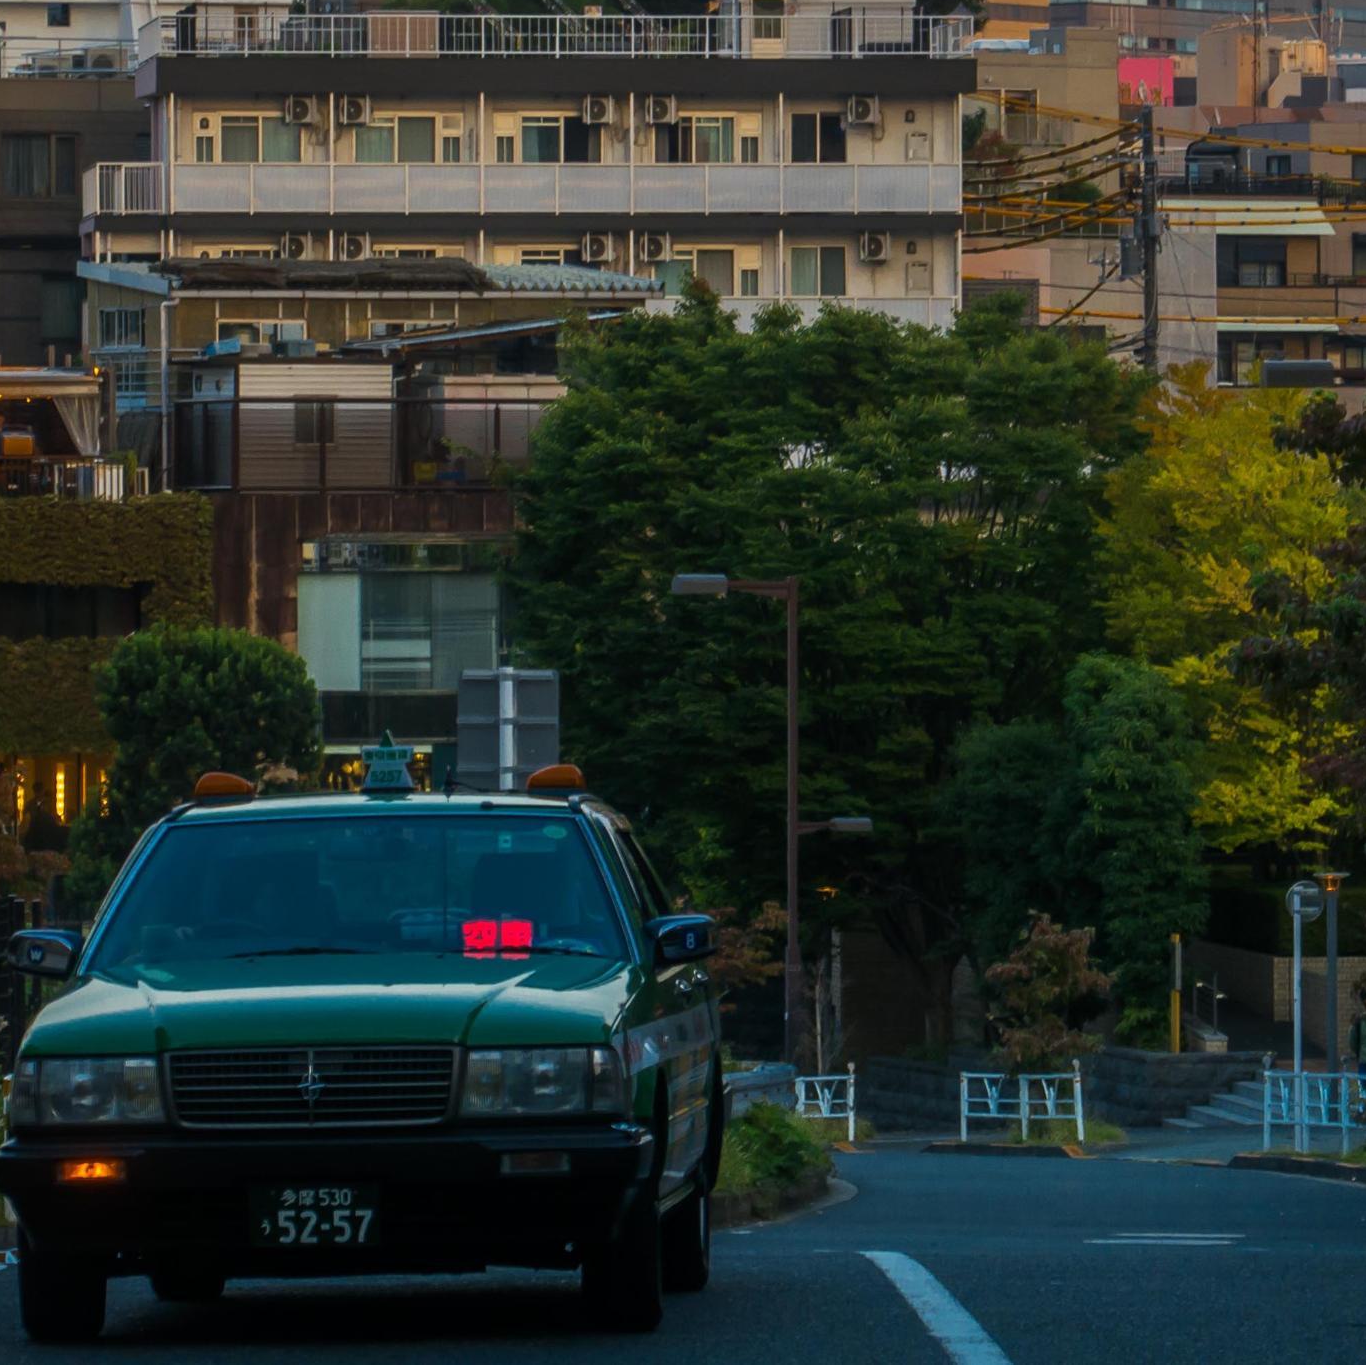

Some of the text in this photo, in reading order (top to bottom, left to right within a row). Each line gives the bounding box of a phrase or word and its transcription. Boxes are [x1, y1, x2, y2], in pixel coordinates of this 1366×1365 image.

[281, 1188, 352, 1207] 多摩 530
[259, 1209, 373, 1244] う 52-57
